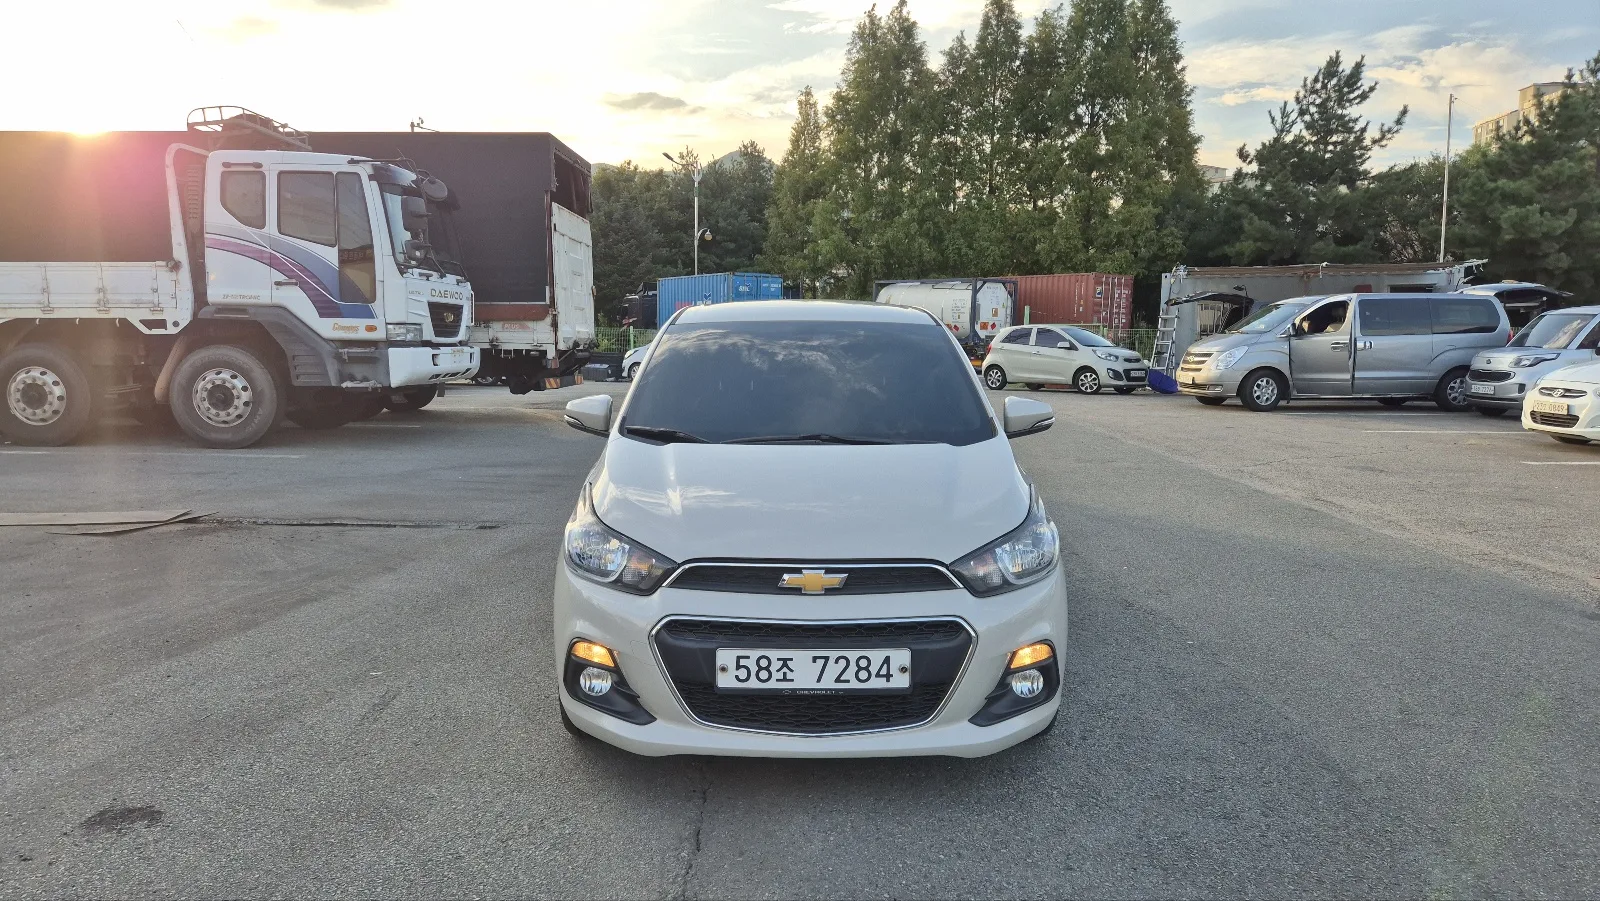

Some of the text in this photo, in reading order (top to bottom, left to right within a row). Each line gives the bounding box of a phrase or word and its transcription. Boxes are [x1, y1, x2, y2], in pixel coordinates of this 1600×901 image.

[430, 288, 463, 301] DAEWOO
[1548, 403, 1566, 413] 0849
[734, 655, 894, 684] 58조 7284
